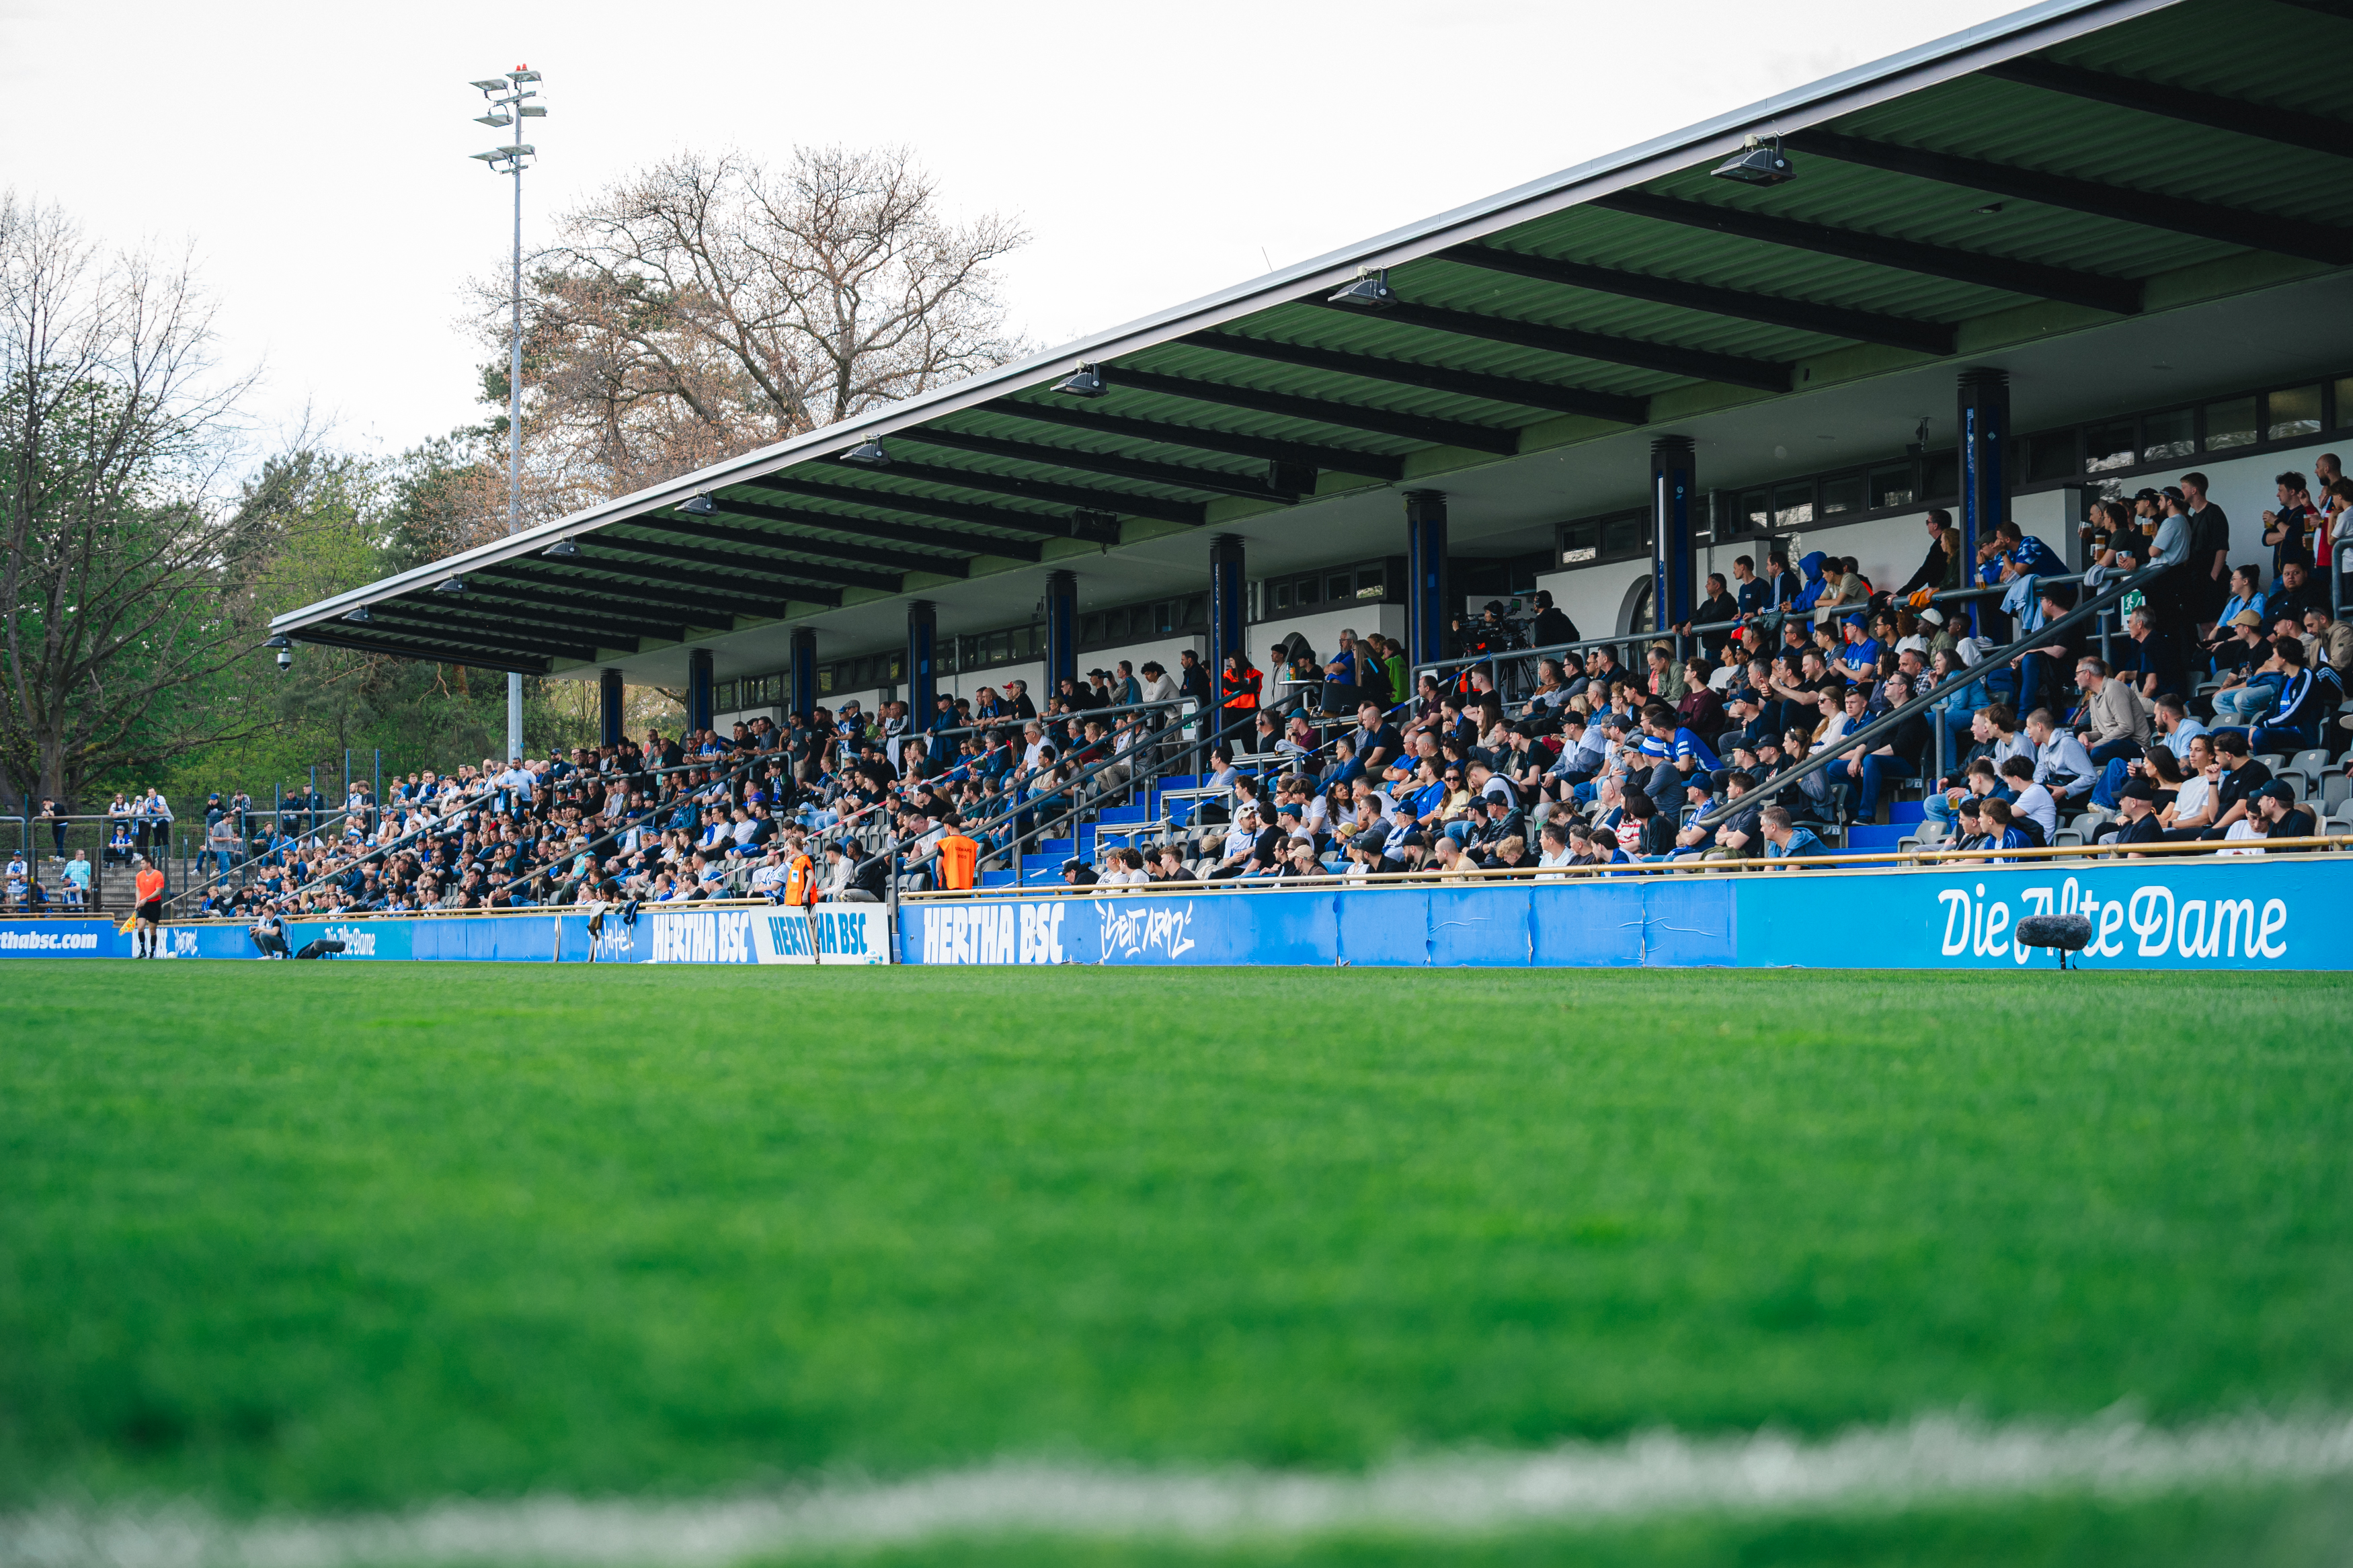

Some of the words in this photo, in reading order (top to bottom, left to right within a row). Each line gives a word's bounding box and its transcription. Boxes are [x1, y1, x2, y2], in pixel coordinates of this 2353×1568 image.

[0, 931, 97, 949] thabsc.com
[353, 927, 376, 956] Dame
[653, 913, 716, 962] HERTHA
[718, 912, 749, 962] BSC
[838, 913, 868, 955] BSC
[924, 905, 1014, 964] HERTHA
[1019, 902, 1065, 964] BSC
[1938, 882, 2009, 957] Die
[2128, 885, 2287, 959] Dame
